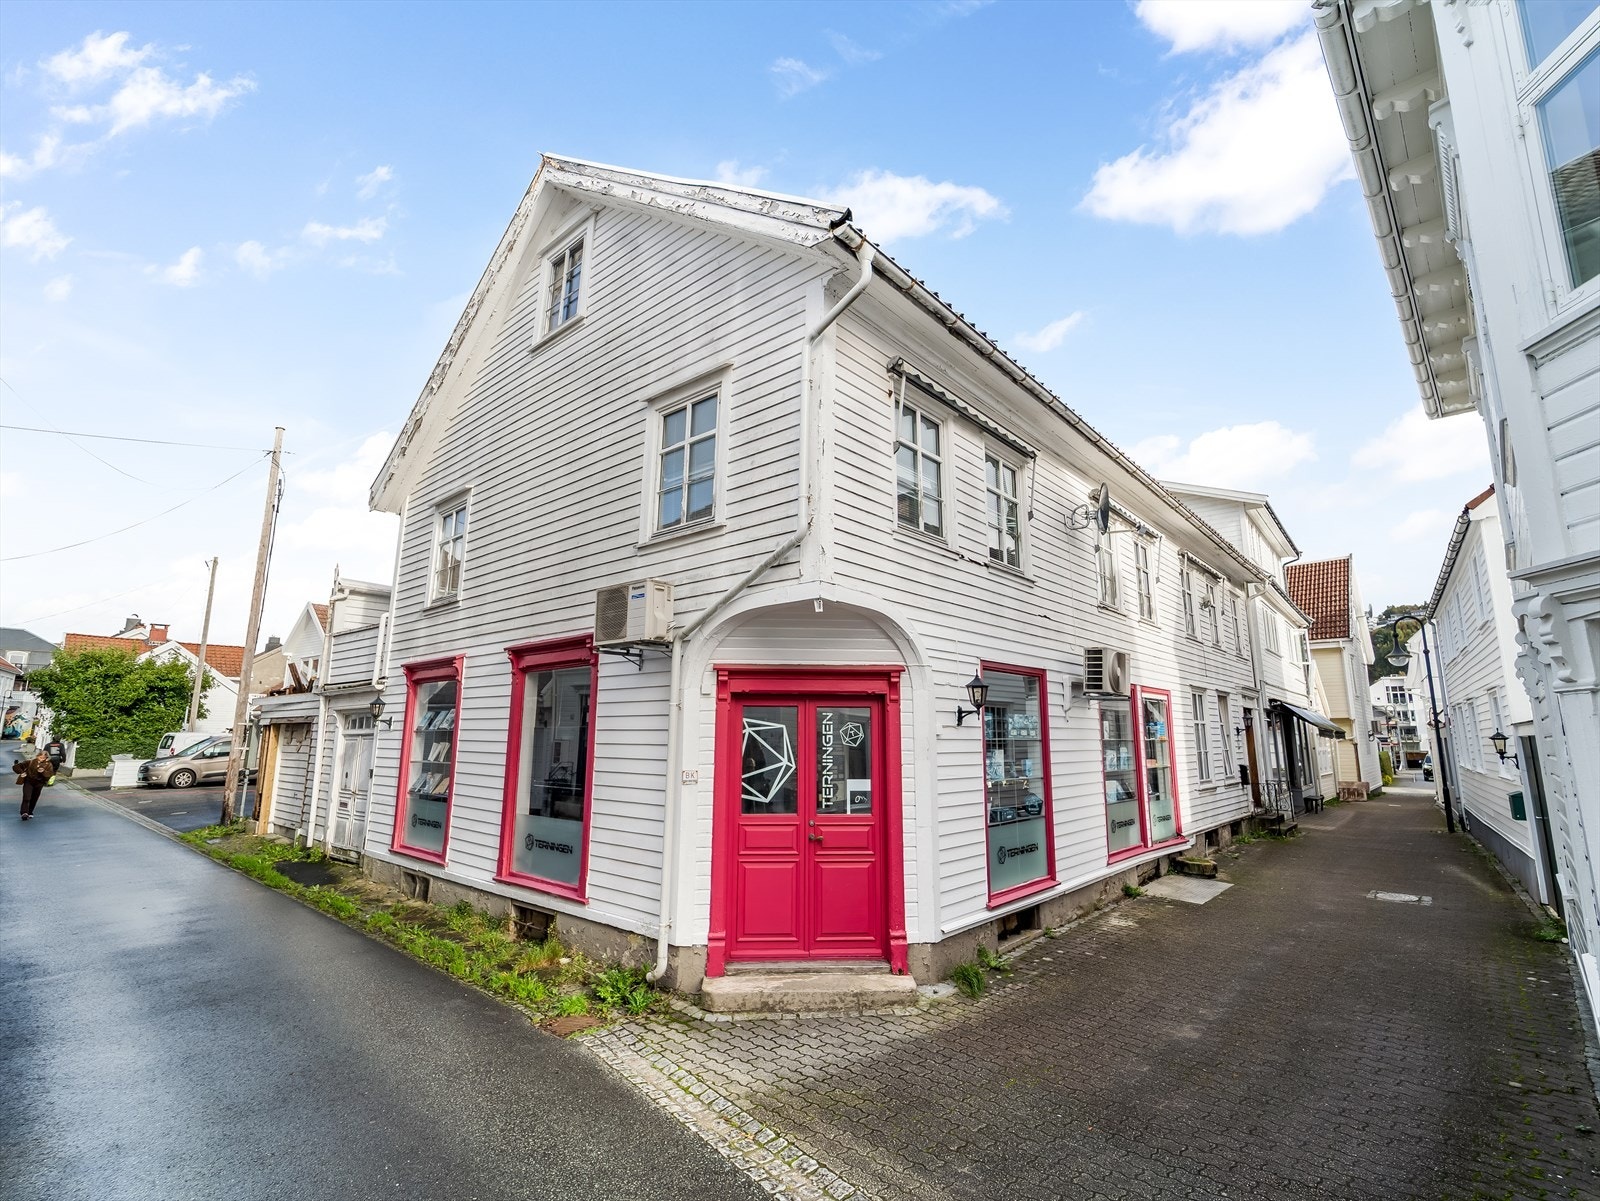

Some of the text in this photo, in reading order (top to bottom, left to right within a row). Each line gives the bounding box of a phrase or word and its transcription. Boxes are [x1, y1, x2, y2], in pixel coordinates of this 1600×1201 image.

[822, 712, 834, 809] TERNINGEN
[534, 838, 573, 855] TERNINGEN
[1006, 843, 1039, 858] TERNINGEN
